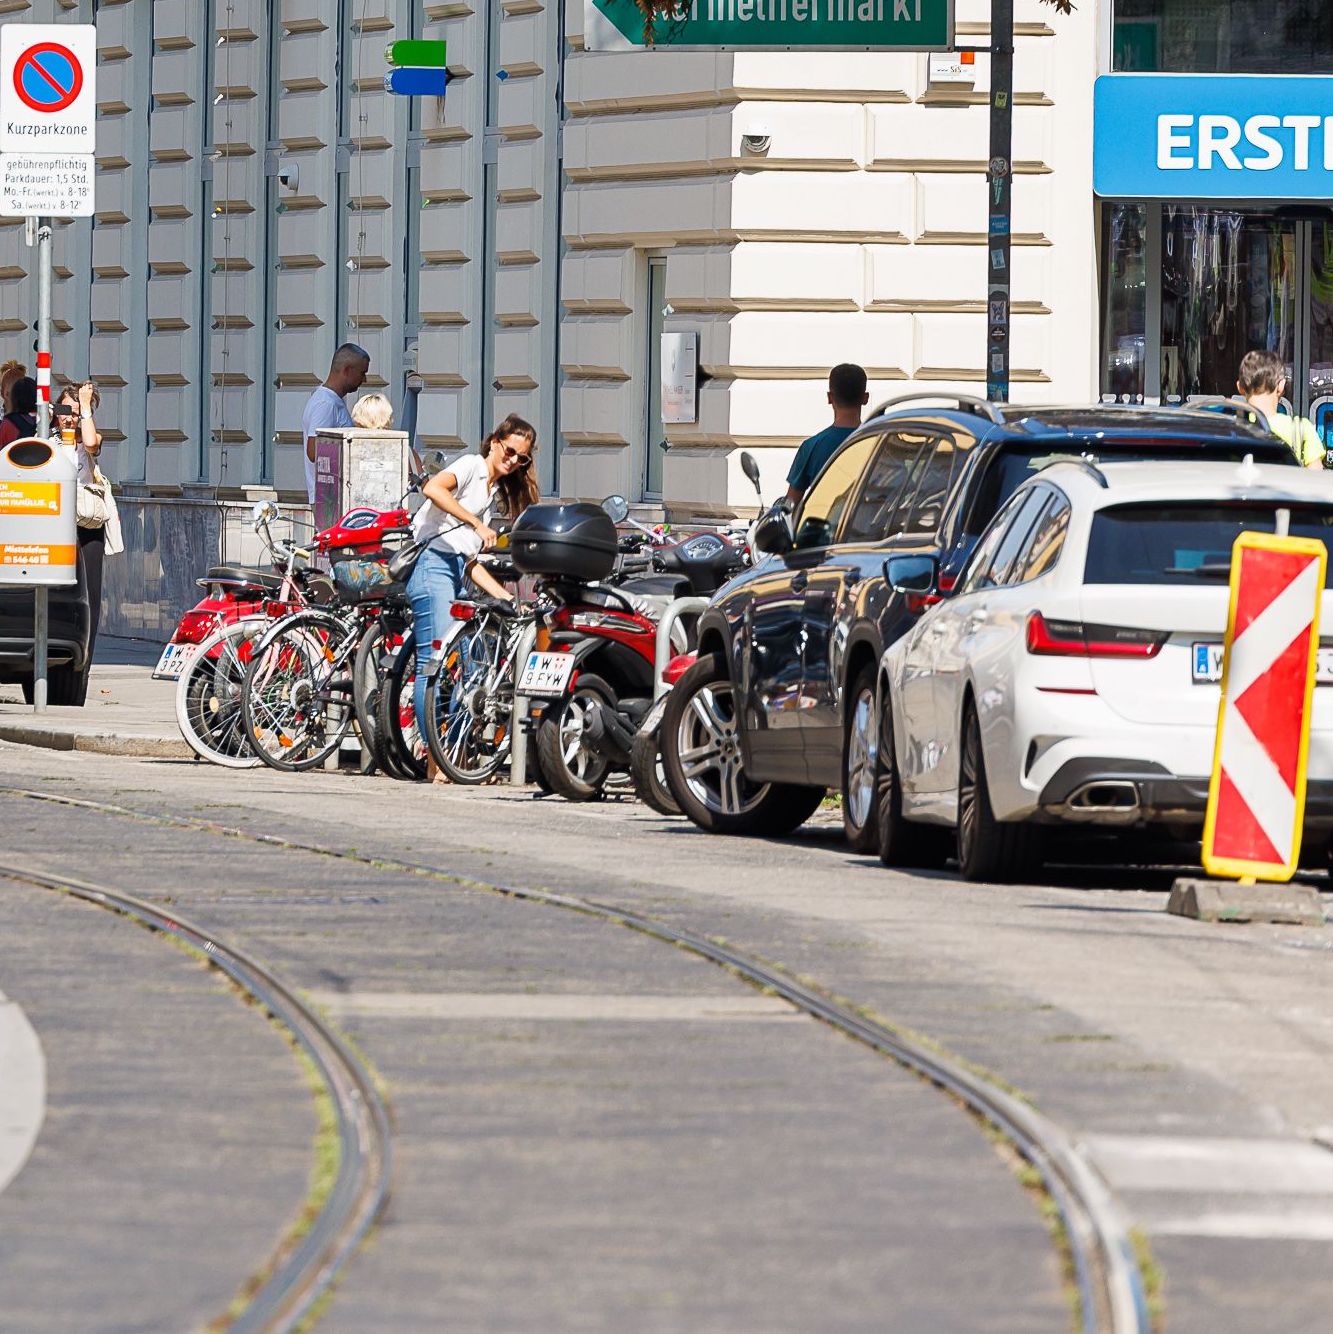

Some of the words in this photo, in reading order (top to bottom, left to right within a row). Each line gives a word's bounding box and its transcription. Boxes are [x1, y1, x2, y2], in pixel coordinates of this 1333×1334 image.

[7, 122, 88, 137] Kurzparkzone
[7, 159, 87, 171] gebührenpflichtig
[5, 174, 53, 183] Parkdauer:
[56, 174, 68, 184] 1,5
[71, 174, 89, 183] Std.
[4, 545, 50, 554] Misttelefon
[12, 556, 28, 564] 546
[541, 657, 553, 670] W
